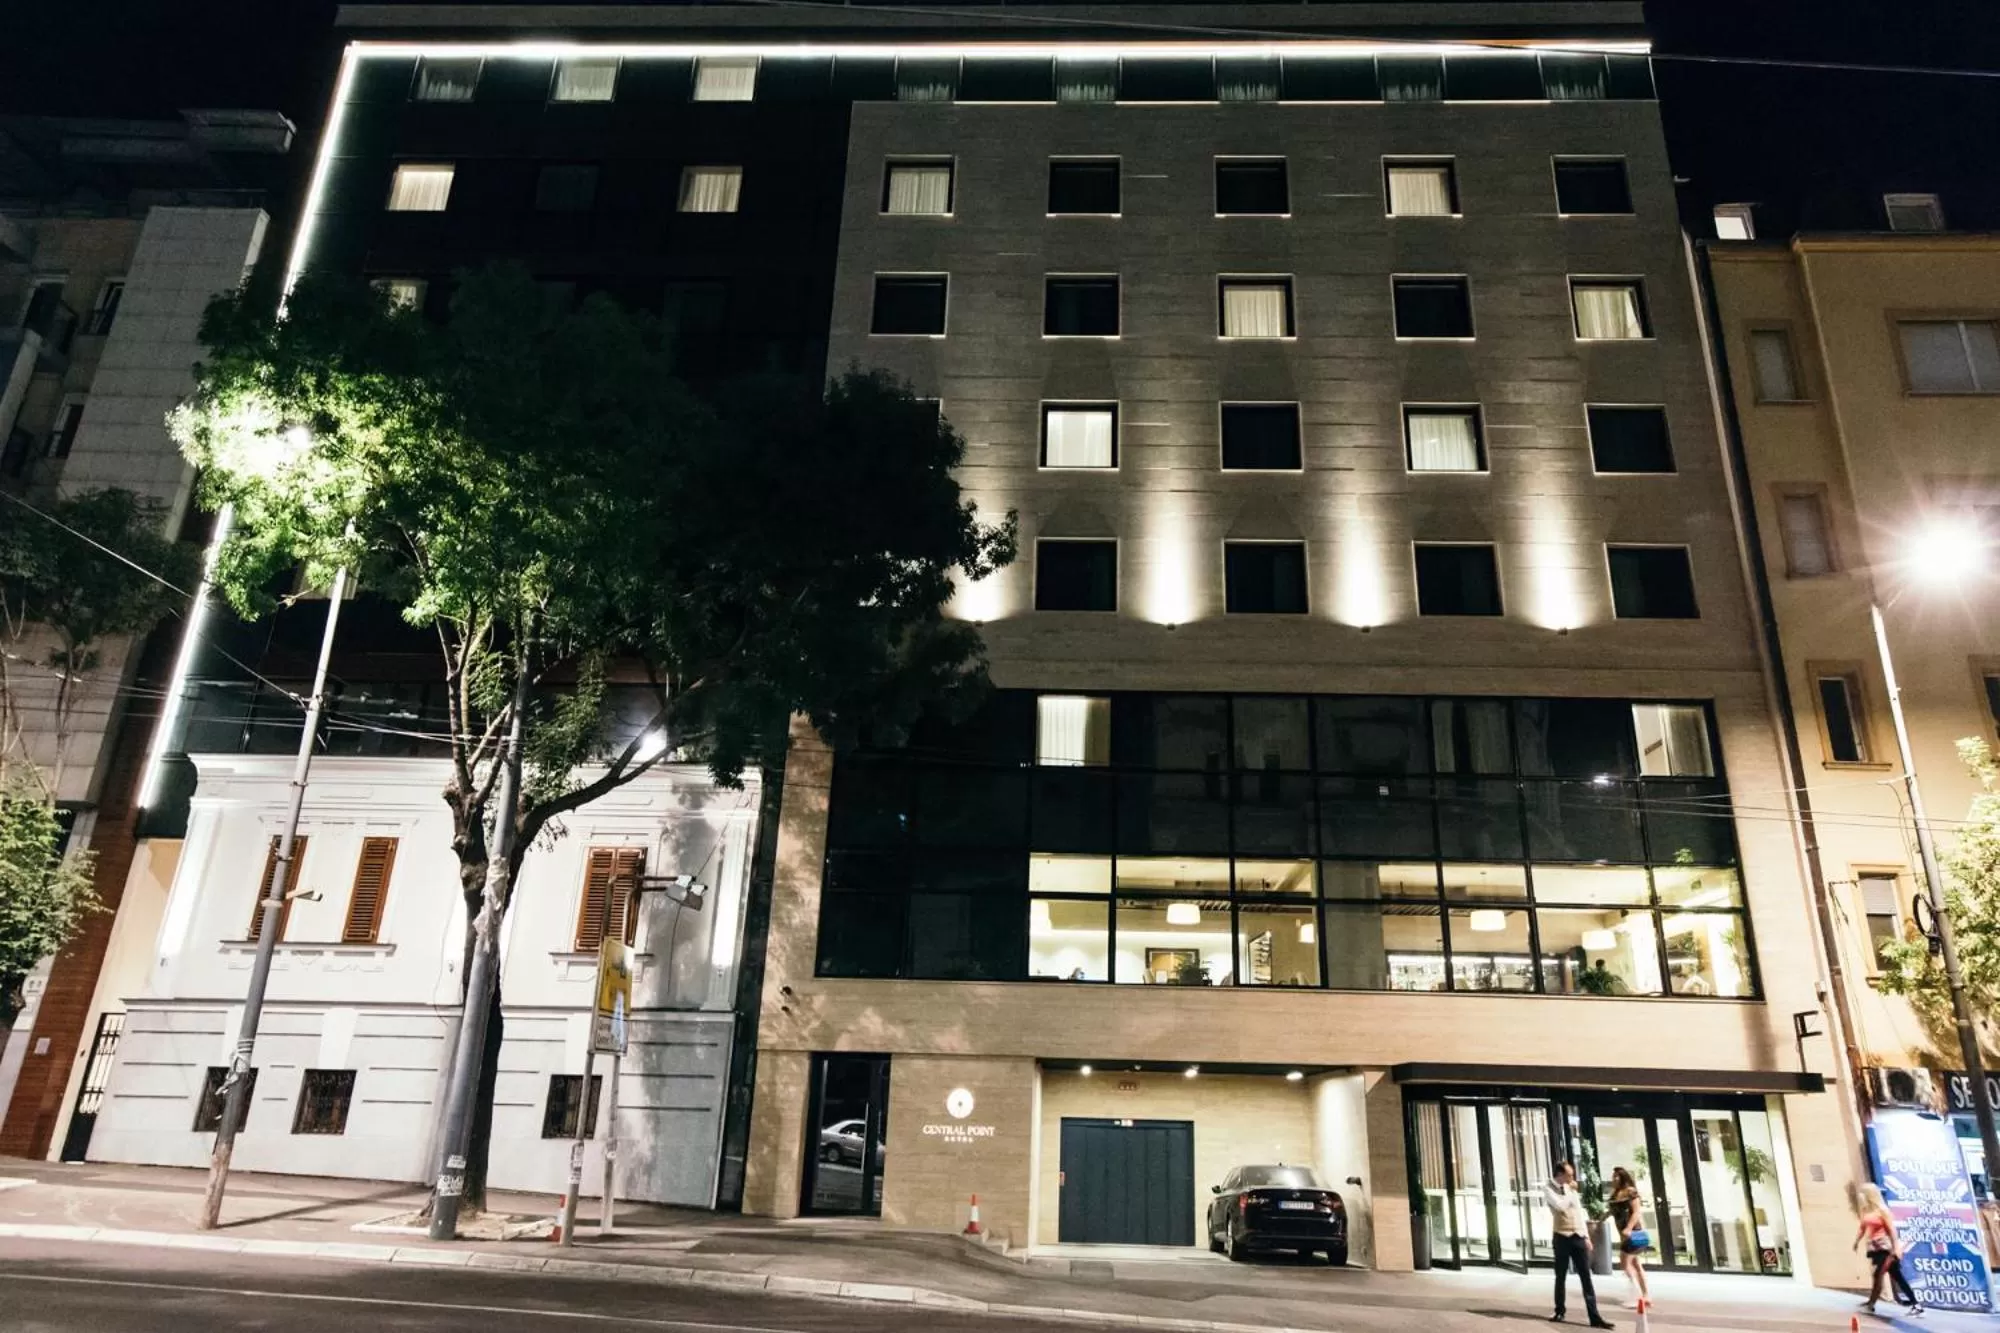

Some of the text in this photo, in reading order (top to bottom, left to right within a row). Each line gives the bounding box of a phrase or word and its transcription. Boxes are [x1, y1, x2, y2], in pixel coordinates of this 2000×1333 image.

[1951, 1076, 2000, 1109] SEO
[922, 1125, 995, 1136] CENTRAL POINT
[1914, 1258, 1974, 1272] SECOND
[1926, 1274, 1968, 1287] HAND
[1914, 1289, 1989, 1305] BOUTIQUE
